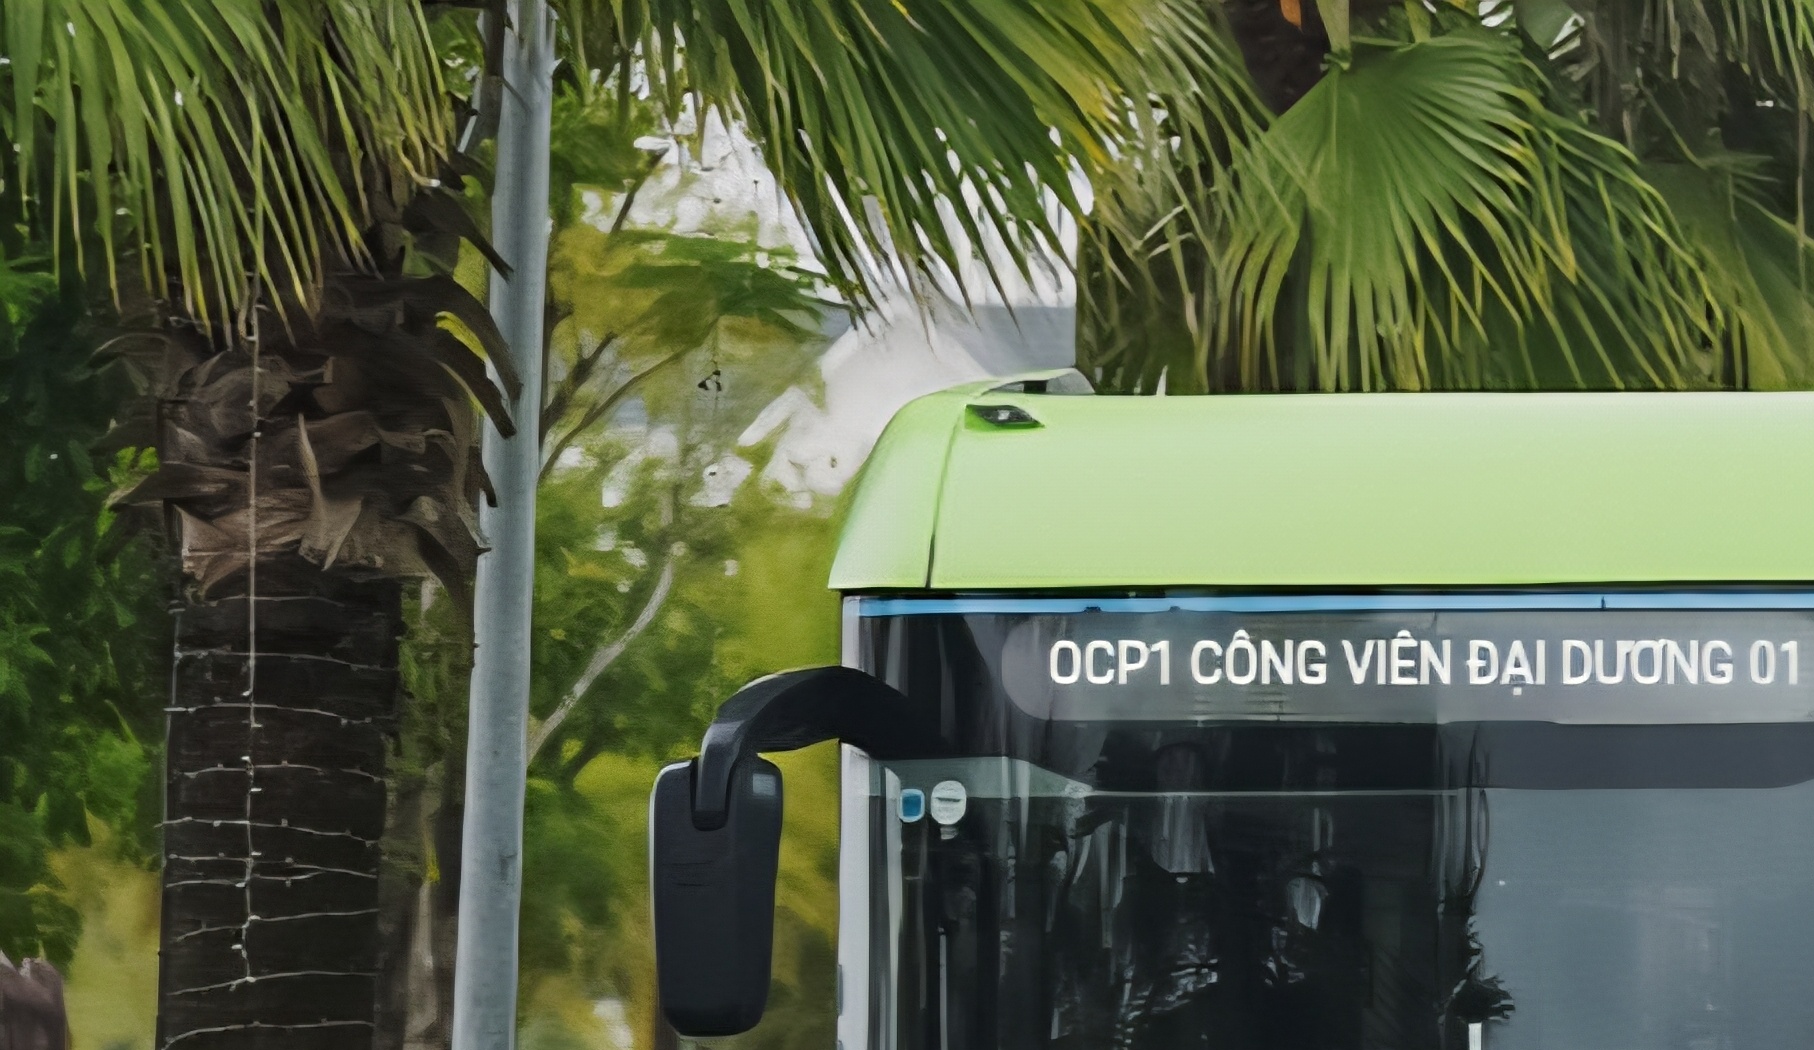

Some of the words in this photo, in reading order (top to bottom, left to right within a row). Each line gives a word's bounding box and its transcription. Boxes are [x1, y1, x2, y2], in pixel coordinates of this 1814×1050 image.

[1049, 639, 1171, 686] OCP1
[1190, 629, 1328, 686] CÔNG
[1341, 629, 1452, 686] VIÊN
[1466, 639, 1547, 696] ĐẠI
[1562, 638, 1735, 686] DƯƠNG
[1749, 639, 1799, 686] 01
